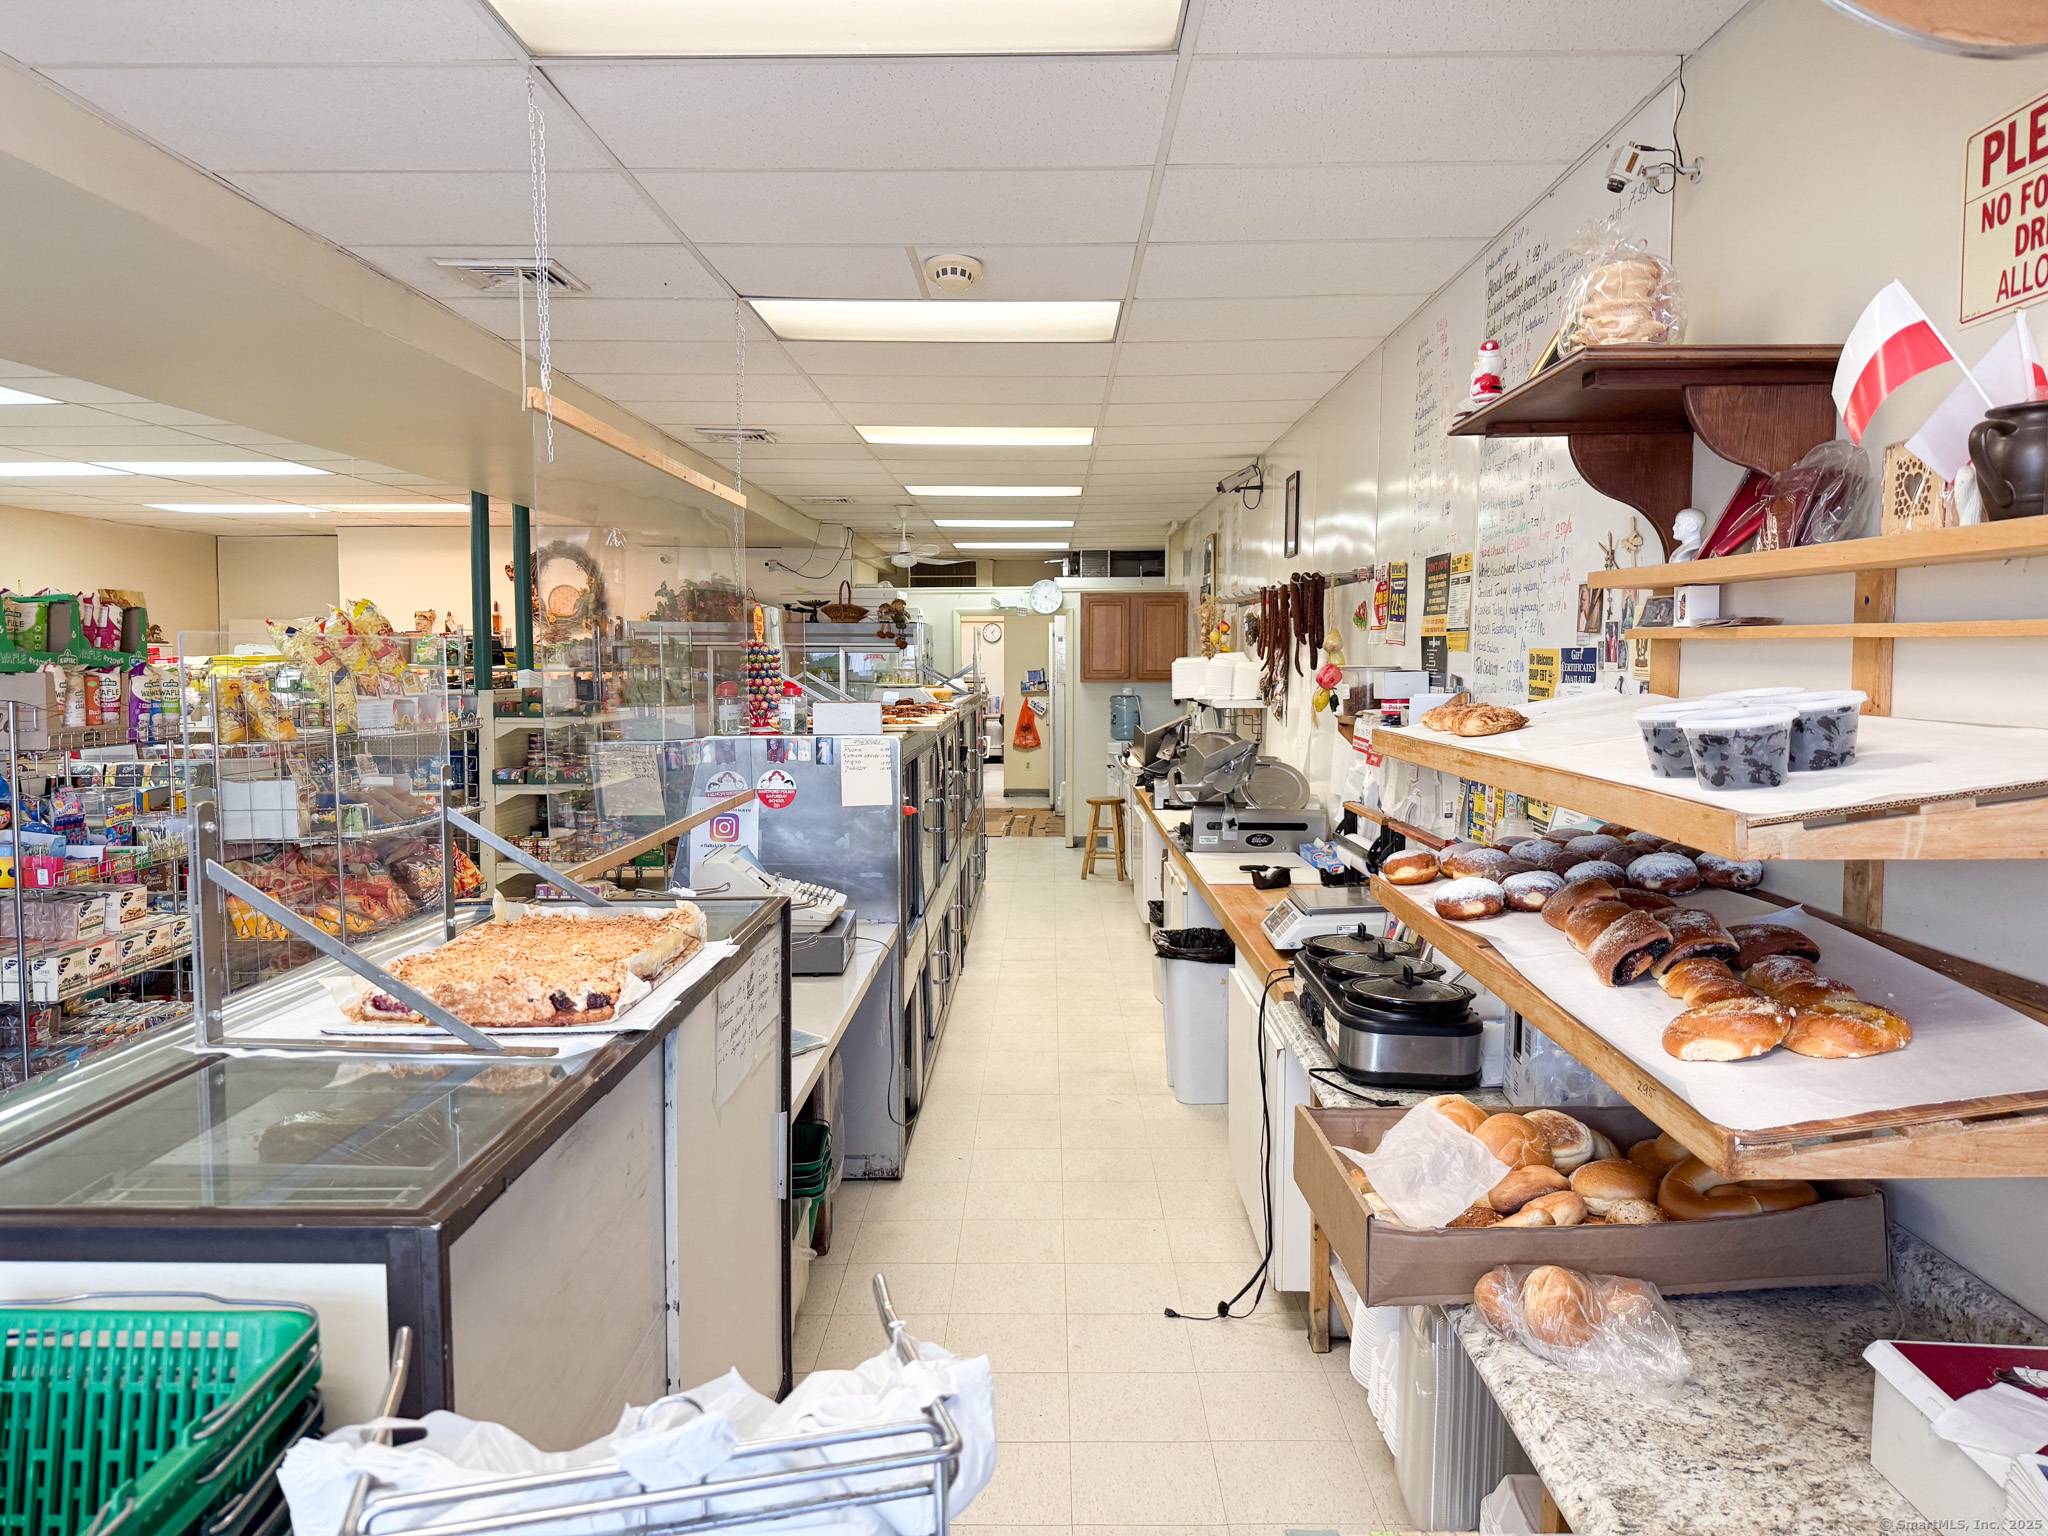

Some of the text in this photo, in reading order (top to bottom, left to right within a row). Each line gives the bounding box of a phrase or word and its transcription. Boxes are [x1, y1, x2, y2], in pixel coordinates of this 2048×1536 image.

[1981, 173, 2048, 233] NO FO
[1996, 253, 2048, 304] ALLO
[1536, 653, 1553, 667] Welcome
[1561, 661, 1595, 672] CERTIFICATES
